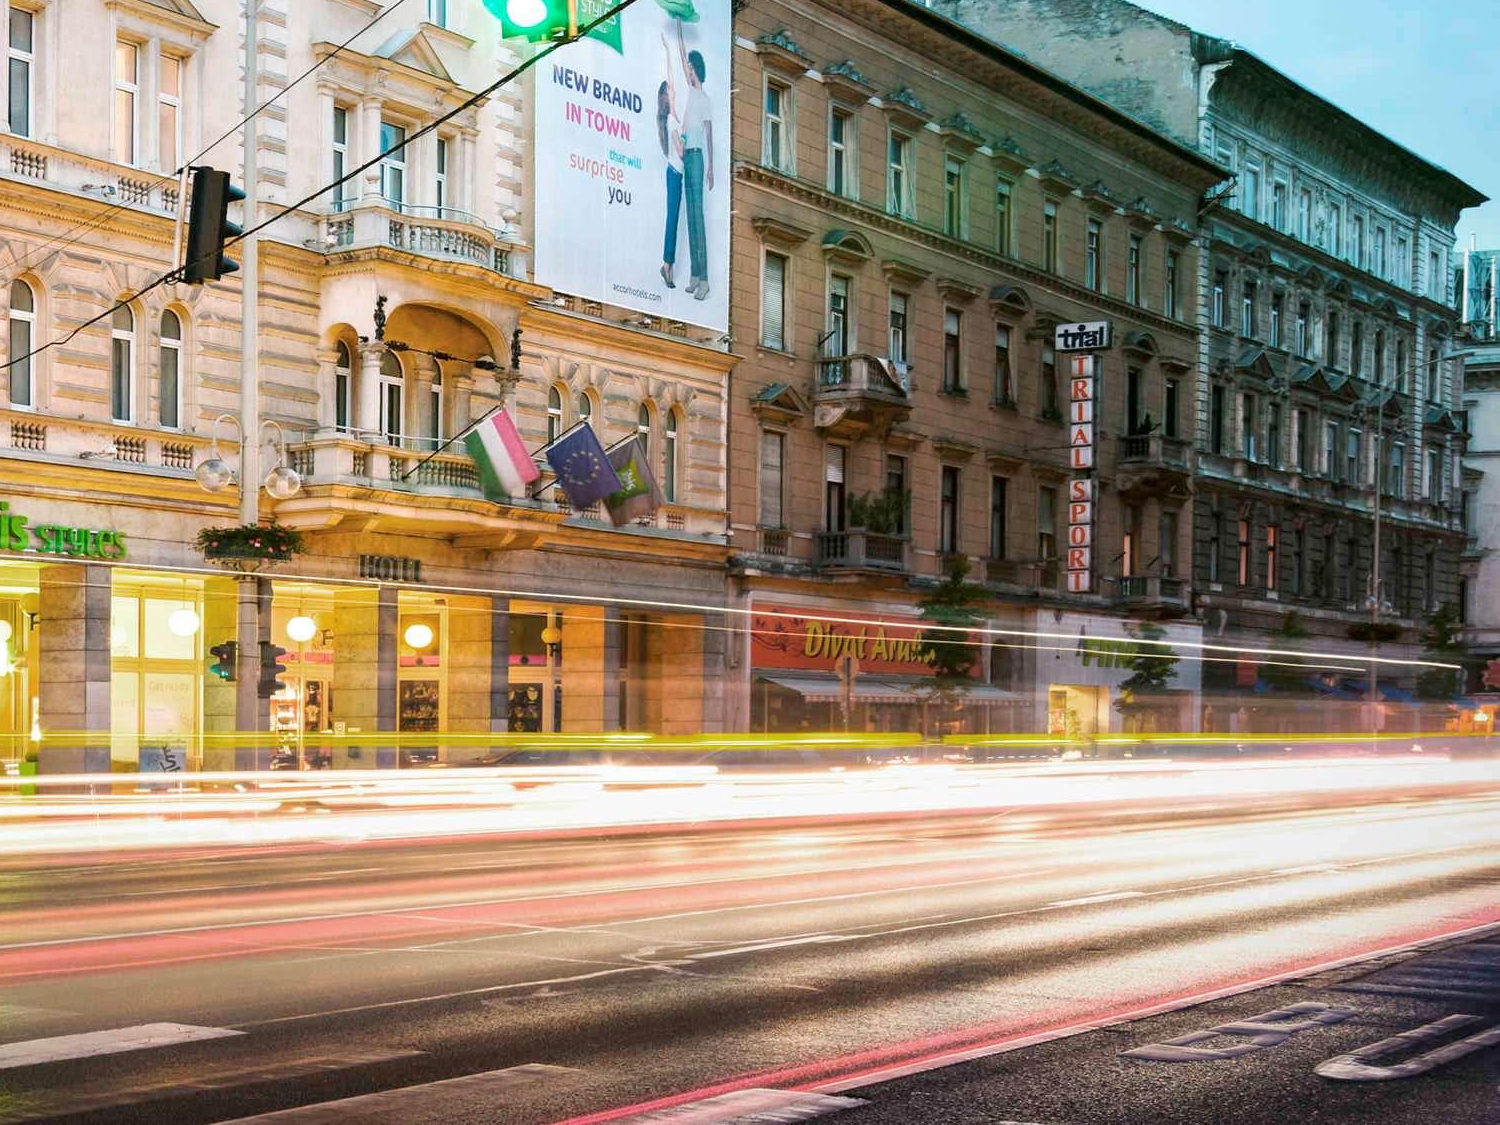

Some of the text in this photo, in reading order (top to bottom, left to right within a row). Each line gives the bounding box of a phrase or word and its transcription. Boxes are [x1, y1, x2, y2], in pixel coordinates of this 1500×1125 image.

[553, 64, 642, 114] NEW BRAND
[565, 101, 630, 142] IN TOWN
[569, 153, 624, 183] surprise
[628, 156, 642, 170] will
[608, 186, 631, 206] you
[1057, 324, 1105, 348] trial
[1069, 480, 1087, 591] SPORT
[803, 621, 867, 661] Divat
